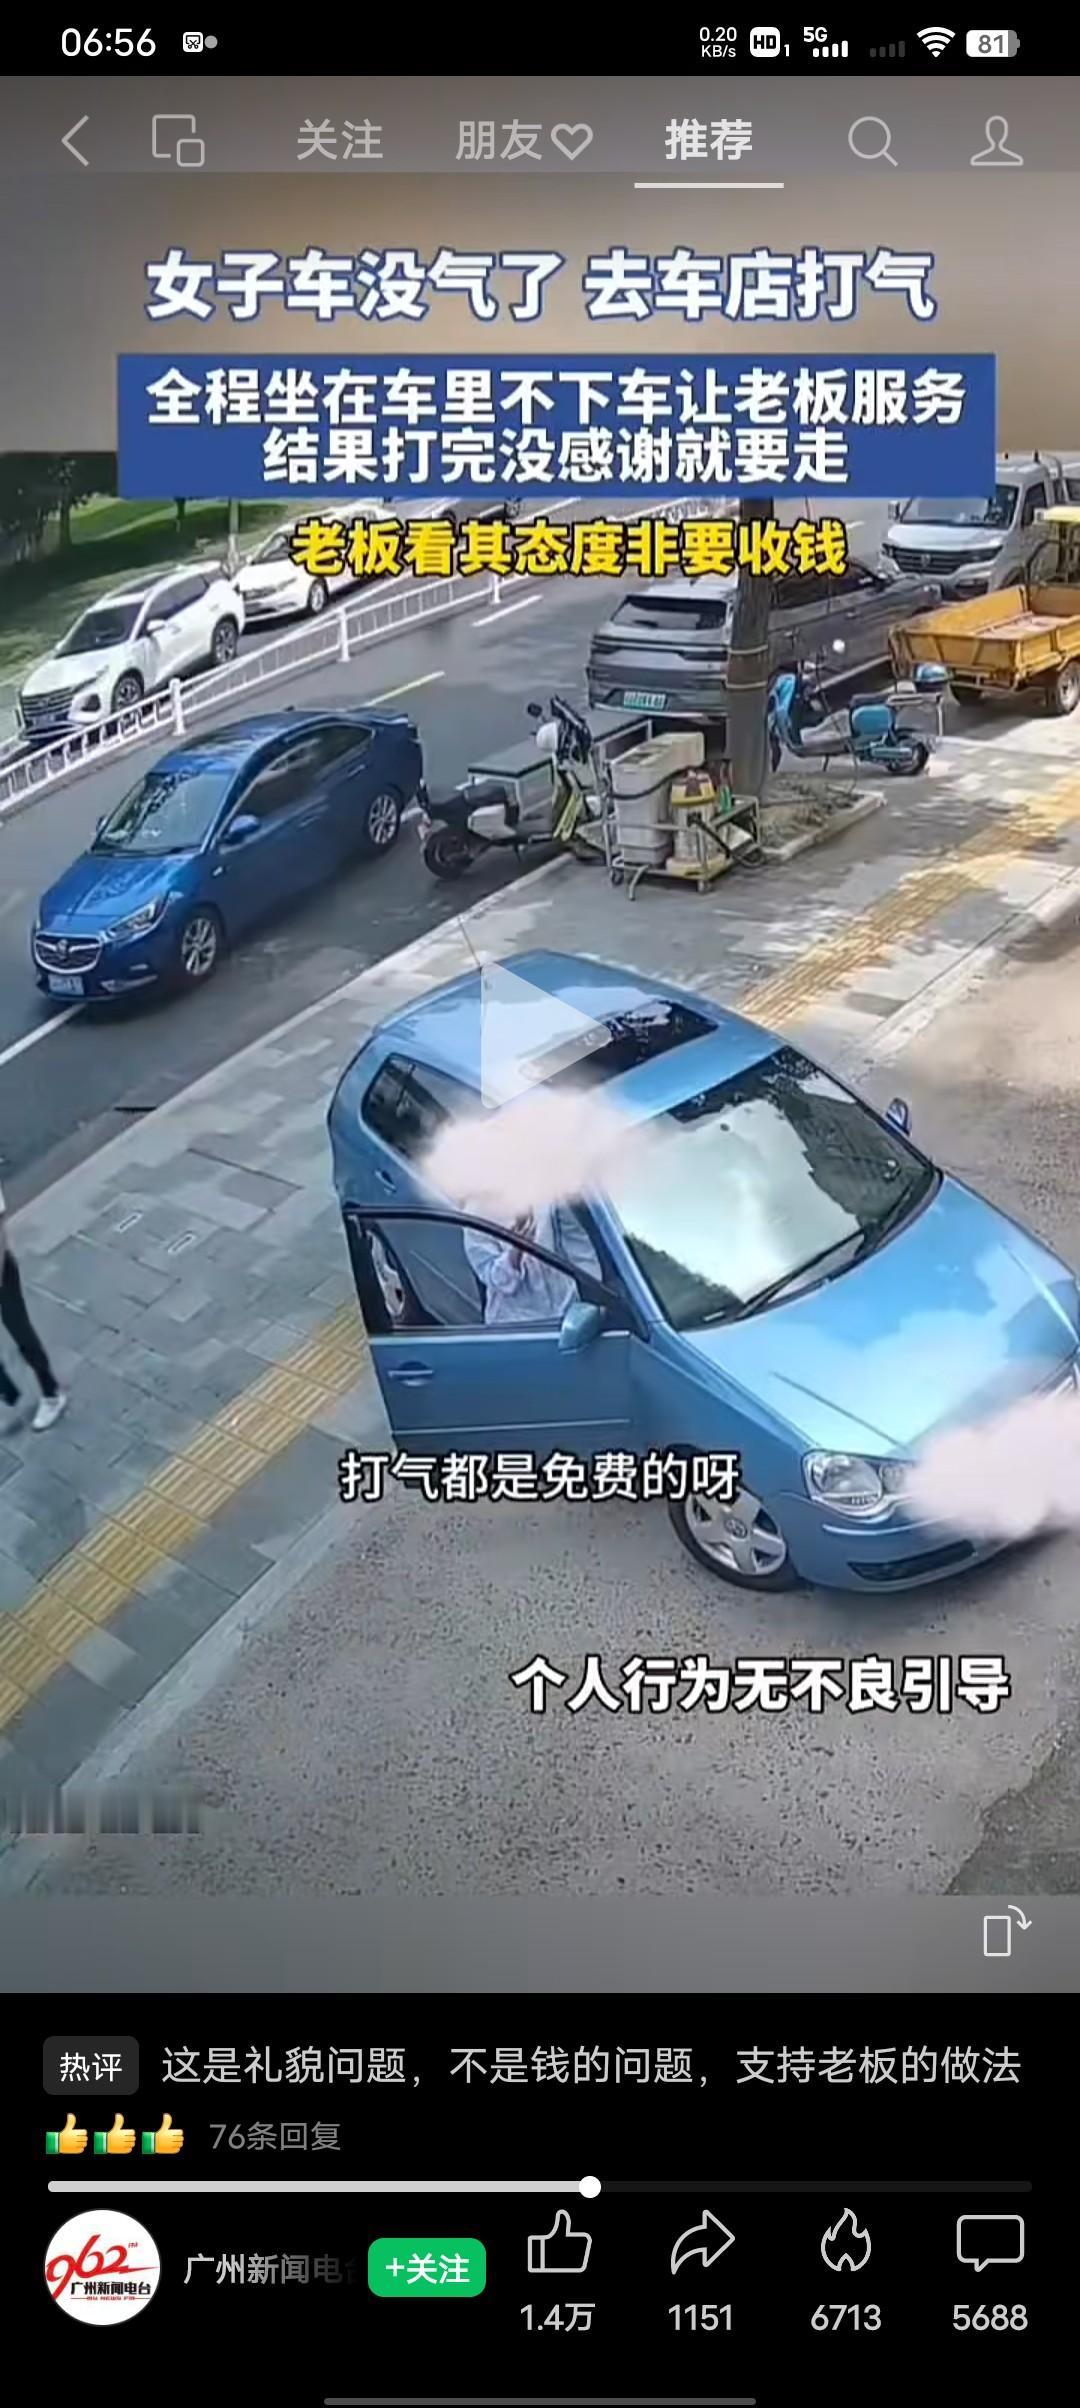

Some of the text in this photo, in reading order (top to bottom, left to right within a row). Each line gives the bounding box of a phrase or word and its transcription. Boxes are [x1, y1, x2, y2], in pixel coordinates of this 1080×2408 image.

[61, 27, 157, 57] 06:56
[699, 26, 738, 42] 0.20
[753, 34, 777, 50] HD
[803, 26, 828, 42] 5G
[977, 34, 1005, 54] 81
[701, 44, 737, 58] KB/s
[296, 118, 385, 161] 关注
[455, 118, 544, 161] 朋友
[664, 117, 753, 161] 推荐
[59, 2051, 123, 2083] 热评
[208, 2120, 342, 2152] 76条回复
[46, 2234, 129, 2300] 962
[385, 2253, 470, 2284] +关注
[70, 2281, 151, 2295] 广州新闻电台
[520, 2303, 597, 2332] 1.4万
[668, 2304, 733, 2331] 1151
[810, 2304, 882, 2331] 6713
[952, 2303, 1029, 2331] 5688
